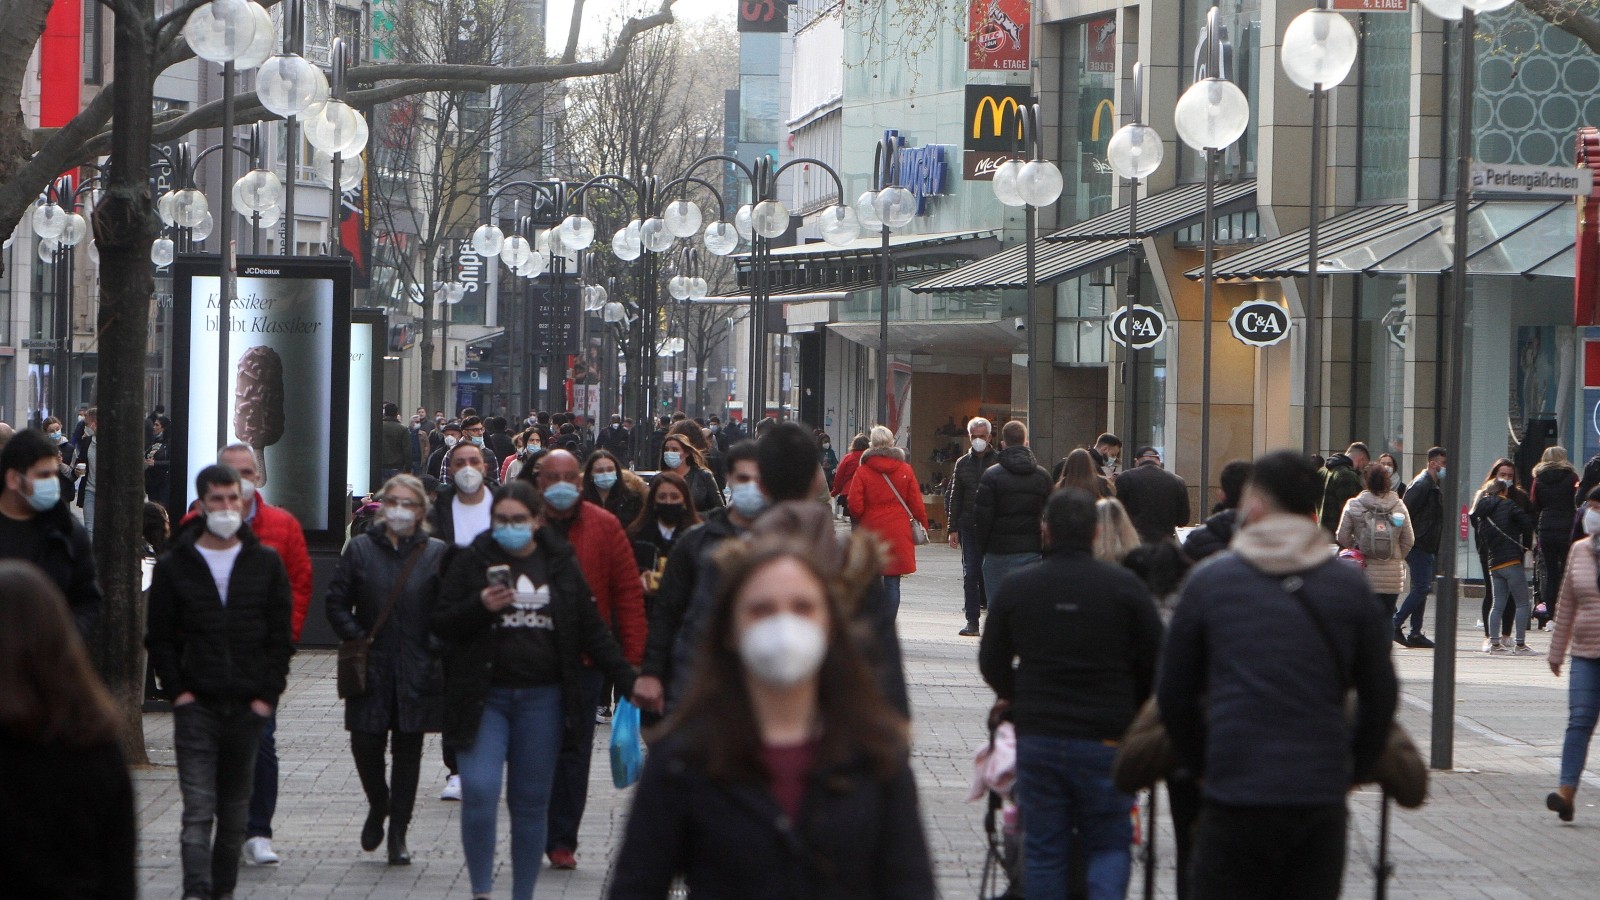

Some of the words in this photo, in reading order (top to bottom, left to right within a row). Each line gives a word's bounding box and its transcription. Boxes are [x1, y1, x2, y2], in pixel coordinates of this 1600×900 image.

[1375, 0, 1404, 8] ETAGE
[993, 60, 1001, 68] 4.
[1003, 60, 1026, 69] ETAGE
[1486, 169, 1579, 190] Perlengäßchen
[244, 267, 280, 275] JCDecaux
[458, 239, 483, 292] snipe
[207, 293, 277, 310] Kssiker
[206, 315, 246, 333] blibt
[251, 316, 322, 334] Klassiker
[1241, 312, 1282, 333] C&A
